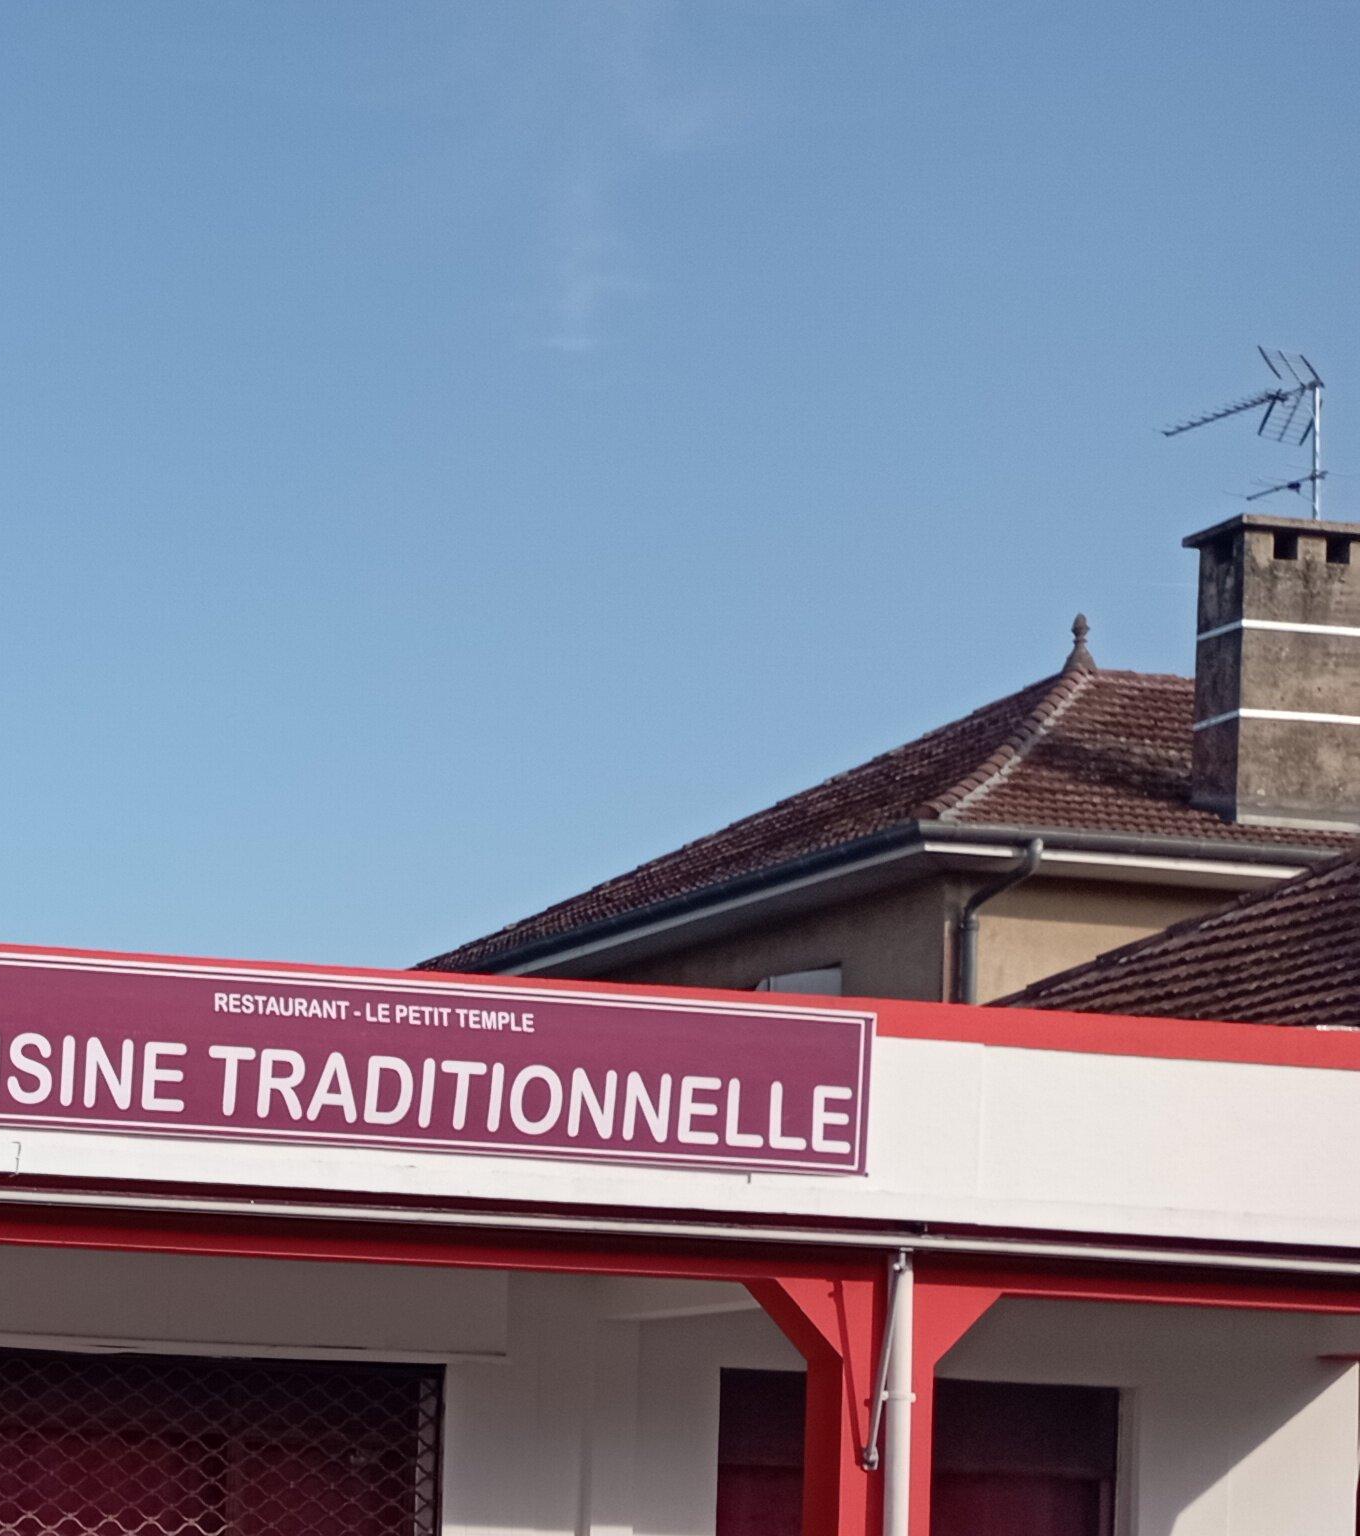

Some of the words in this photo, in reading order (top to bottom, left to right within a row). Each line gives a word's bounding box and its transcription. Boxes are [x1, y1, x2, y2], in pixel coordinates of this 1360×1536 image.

[213, 992, 350, 1021] RESTAURANT
[365, 1002, 391, 1024] LE
[395, 1004, 452, 1028] PETIT
[455, 1008, 536, 1034] TEMPLE
[208, 1044, 853, 1155] TRADITIONNELLE
